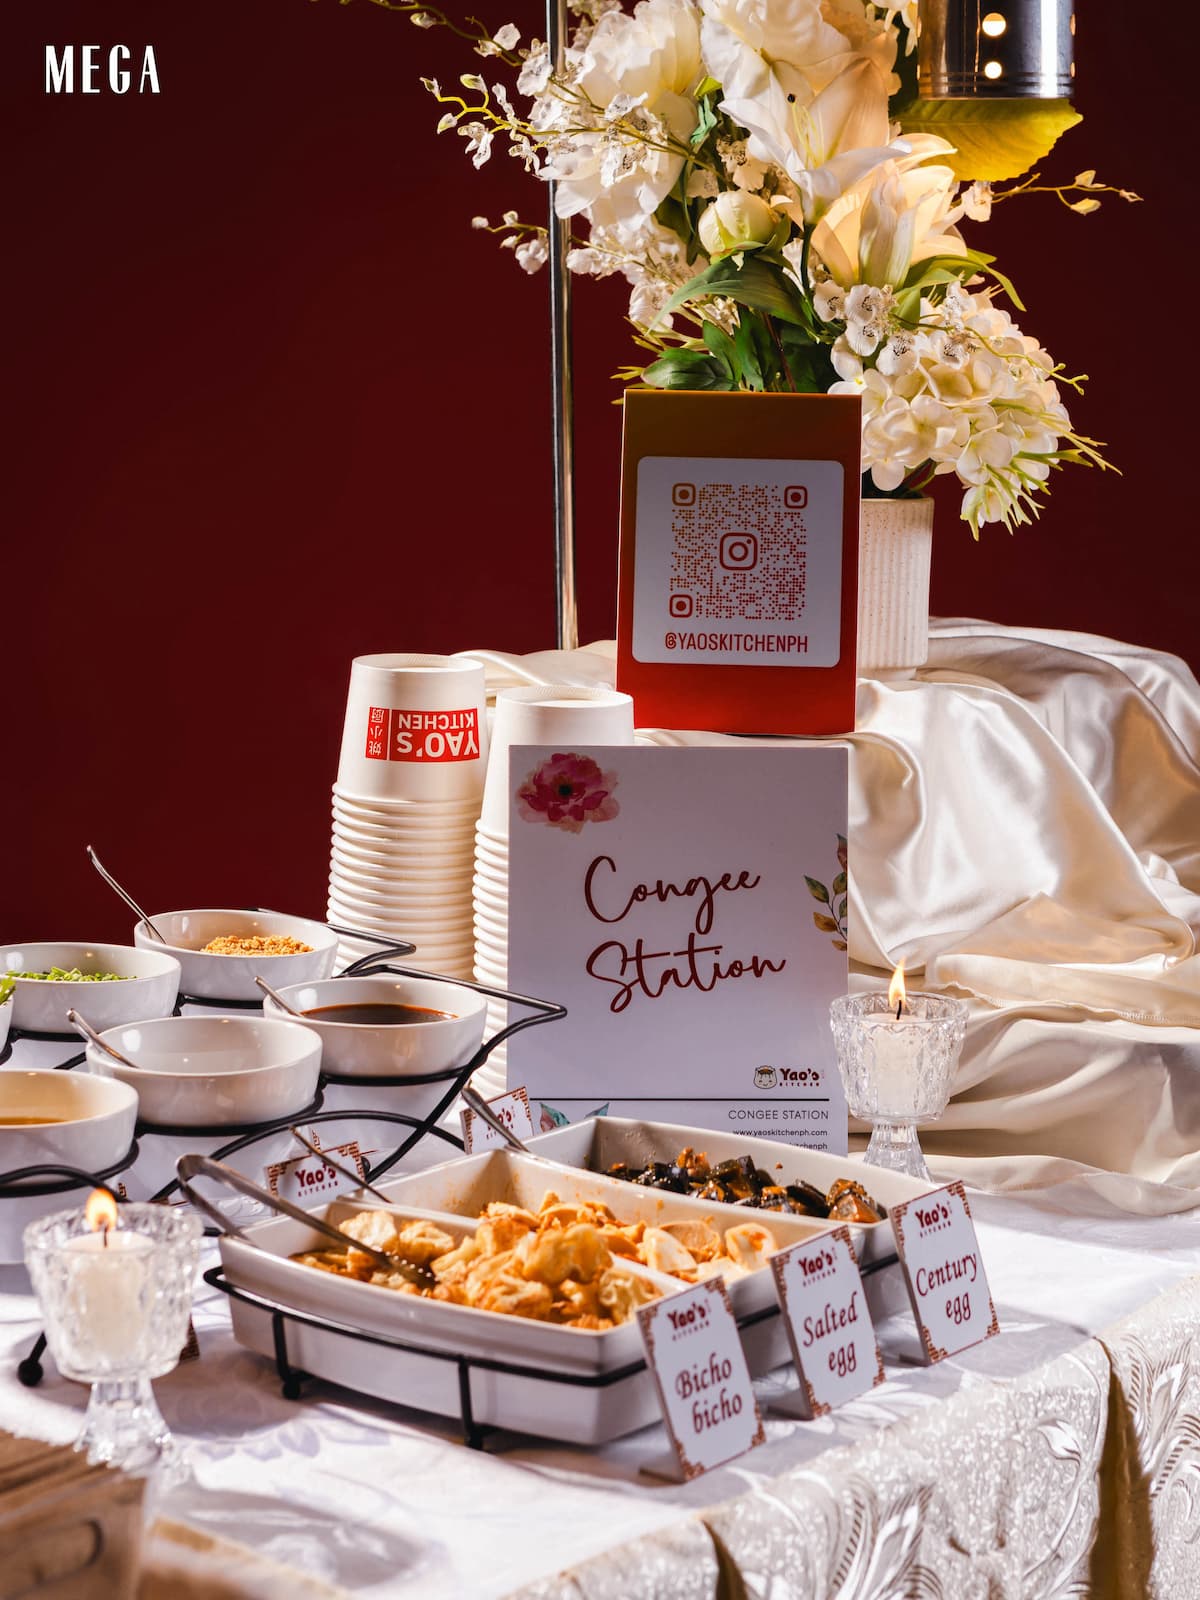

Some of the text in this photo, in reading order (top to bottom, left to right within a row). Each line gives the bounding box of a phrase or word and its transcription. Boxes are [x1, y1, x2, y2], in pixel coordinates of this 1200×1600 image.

[665, 632, 808, 653] @YAOSKITCHENPH
[398, 712, 475, 730] KITCHEN
[396, 730, 479, 758] YAO'S
[584, 855, 761, 935] Congee
[585, 932, 786, 1013] Station
[779, 1068, 820, 1081] Yao's
[728, 1110, 829, 1120] CONGEE STATION
[294, 1161, 337, 1188] Yao's
[914, 1203, 949, 1229] Yao's
[798, 1249, 833, 1277] Yao's
[915, 1252, 977, 1298] Century
[666, 1301, 706, 1330] Yao's
[803, 1291, 858, 1348] Salted
[945, 1292, 971, 1325] egg
[828, 1342, 857, 1378] egg
[675, 1352, 732, 1400] Bicho
[692, 1388, 743, 1435] bicho
